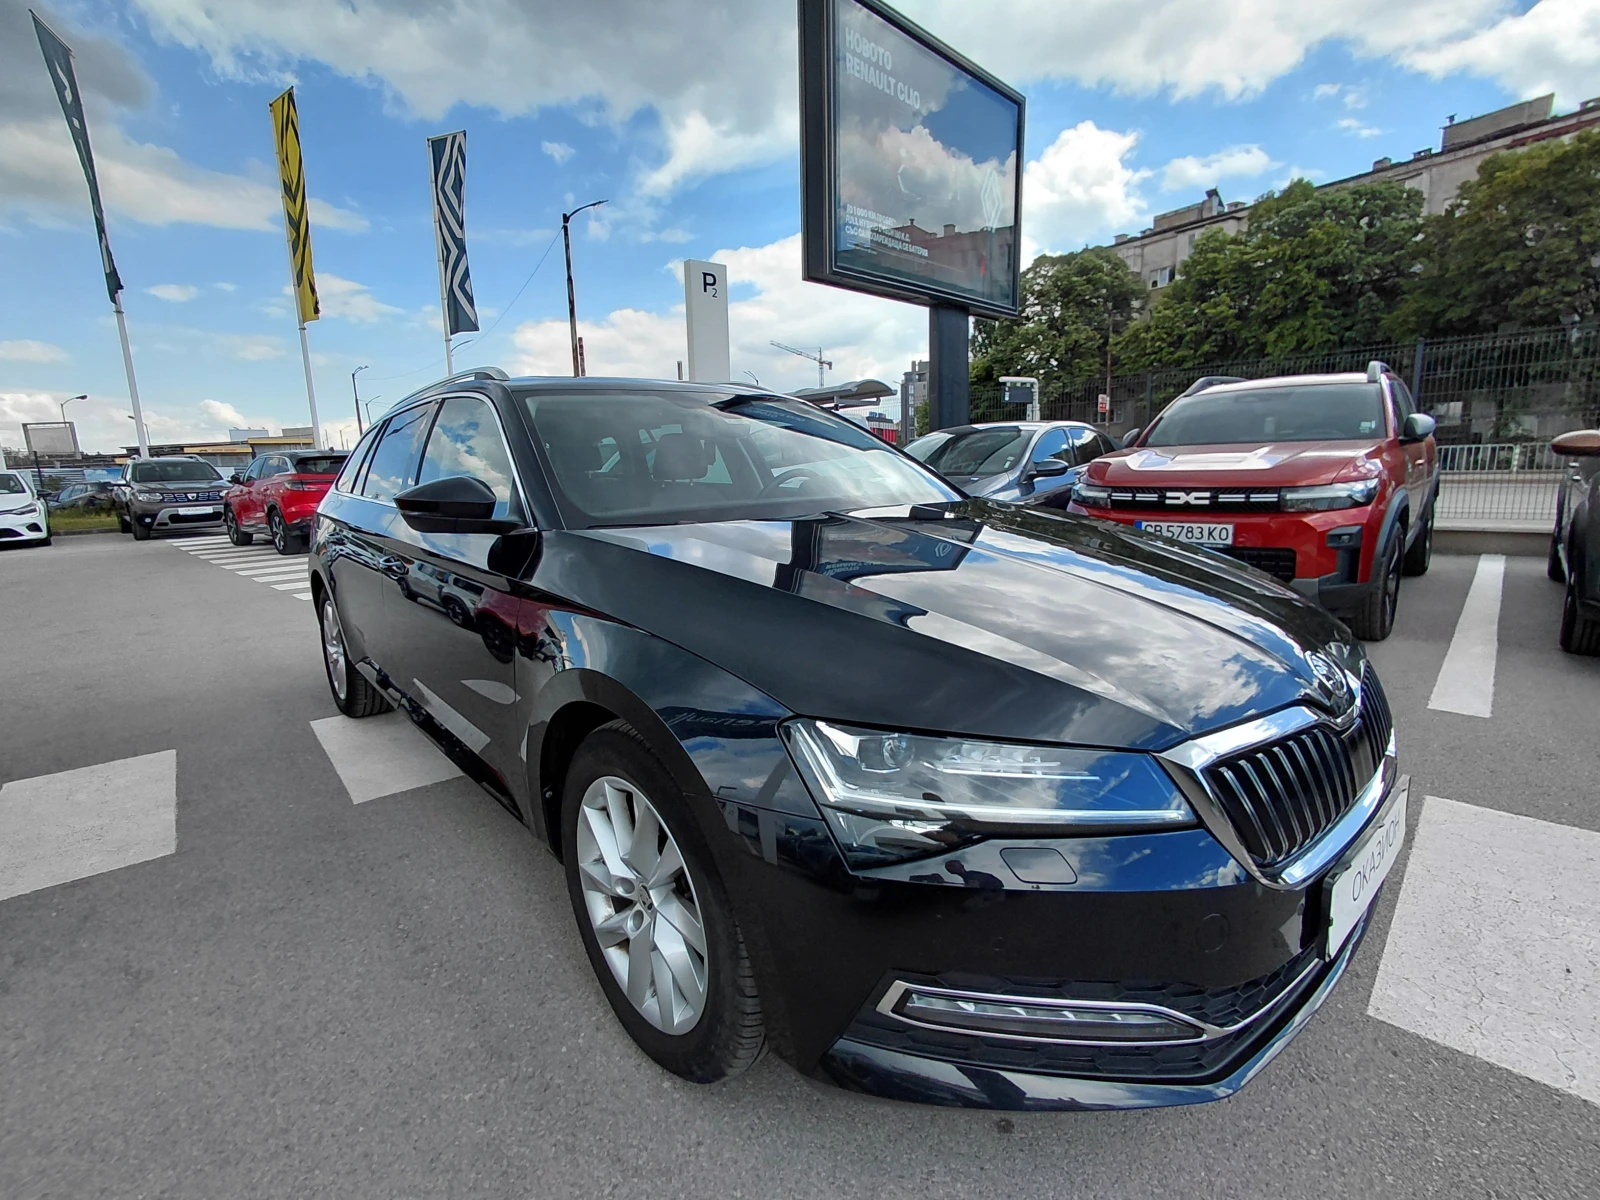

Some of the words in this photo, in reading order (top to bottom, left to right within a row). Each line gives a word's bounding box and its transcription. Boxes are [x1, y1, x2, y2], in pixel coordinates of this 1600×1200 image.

[845, 27, 892, 71] НОВОТО
[845, 52, 896, 96] RENAULT
[897, 81, 920, 110] CLIO
[844, 225, 858, 236] СЪС
[845, 214, 859, 226] FULL
[1352, 809, 1400, 902] ОКАЗИОН
